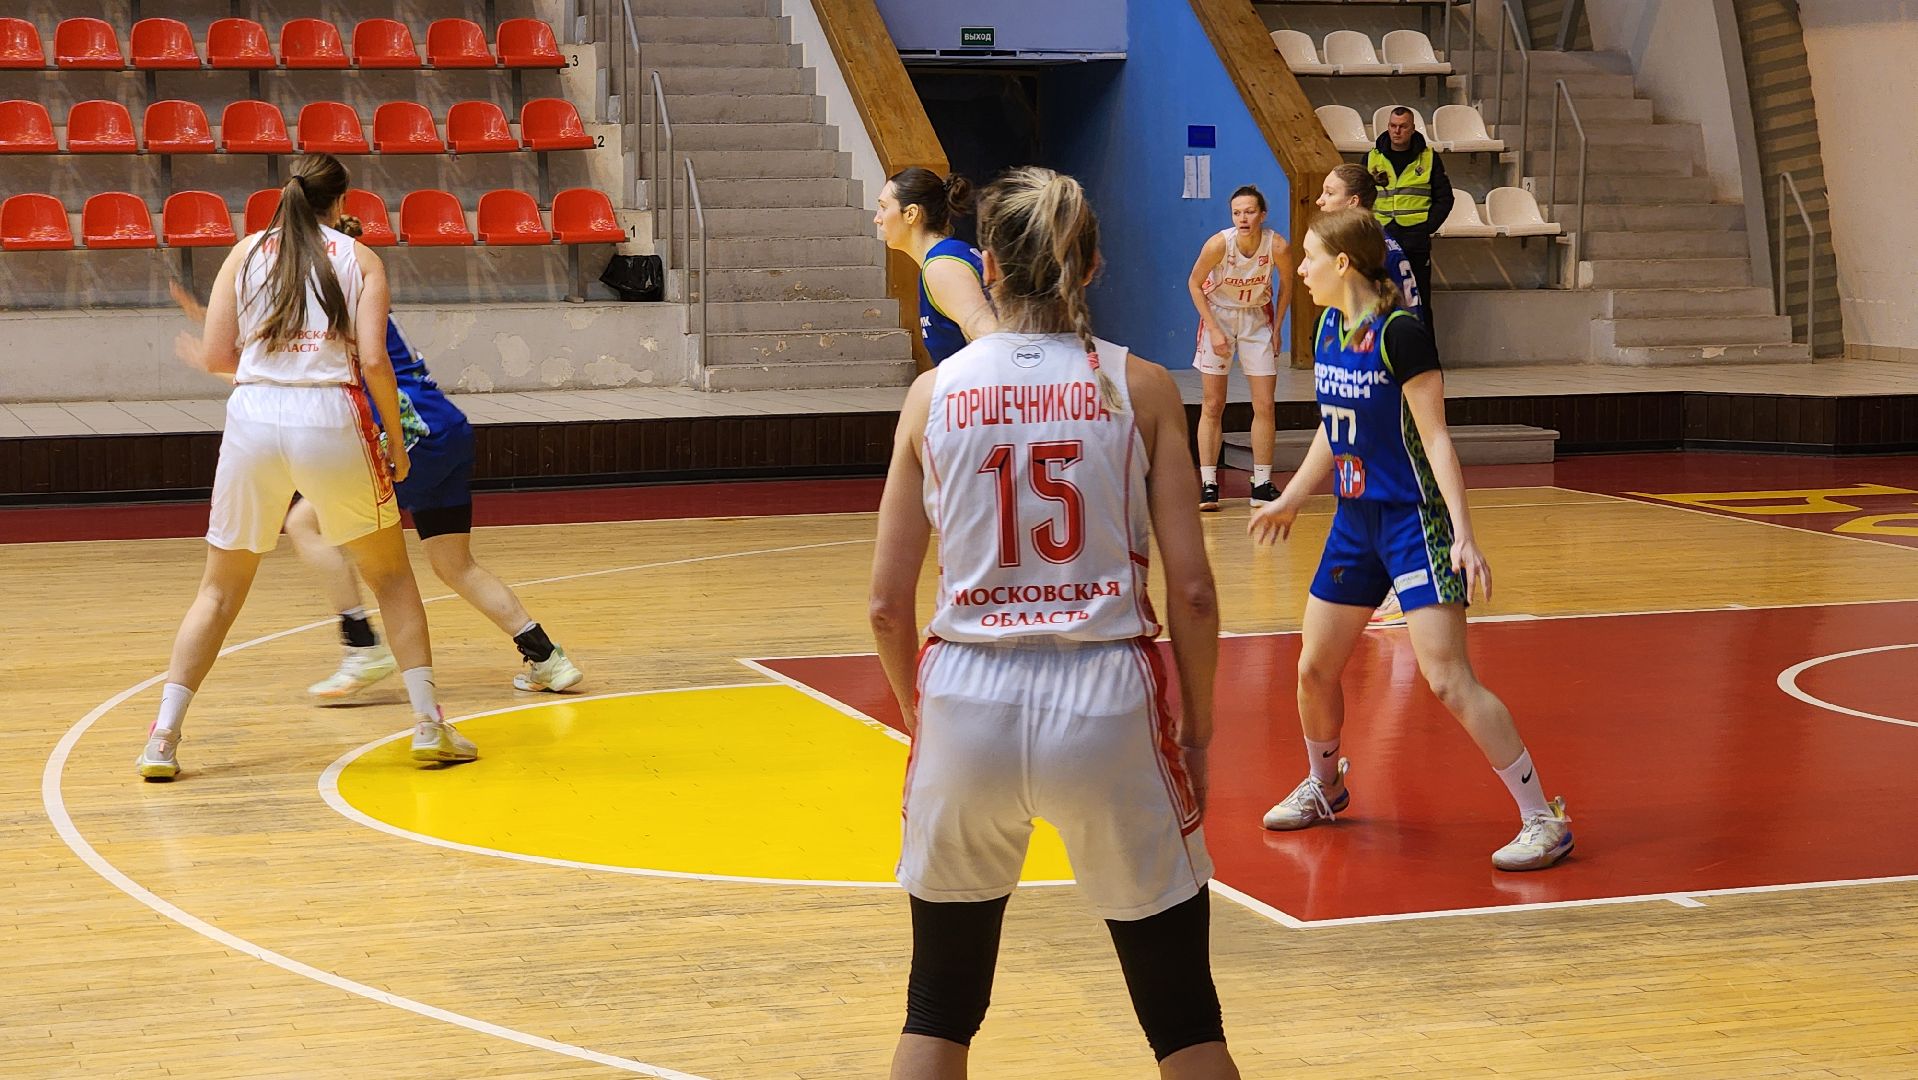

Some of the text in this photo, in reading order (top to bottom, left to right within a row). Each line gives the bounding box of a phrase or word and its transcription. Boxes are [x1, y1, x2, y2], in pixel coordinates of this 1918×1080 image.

[964, 33, 992, 41] ВЫХОД
[572, 54, 579, 67] 3
[597, 135, 605, 148] 2
[630, 225, 636, 238] 1
[1238, 289, 1252, 302] 11
[1320, 403, 1357, 446] 77
[976, 440, 1086, 569] 15
[951, 581, 1121, 606] МОСКОВСКАЯ
[980, 610, 1089, 627] ОБЛАСТЬ
